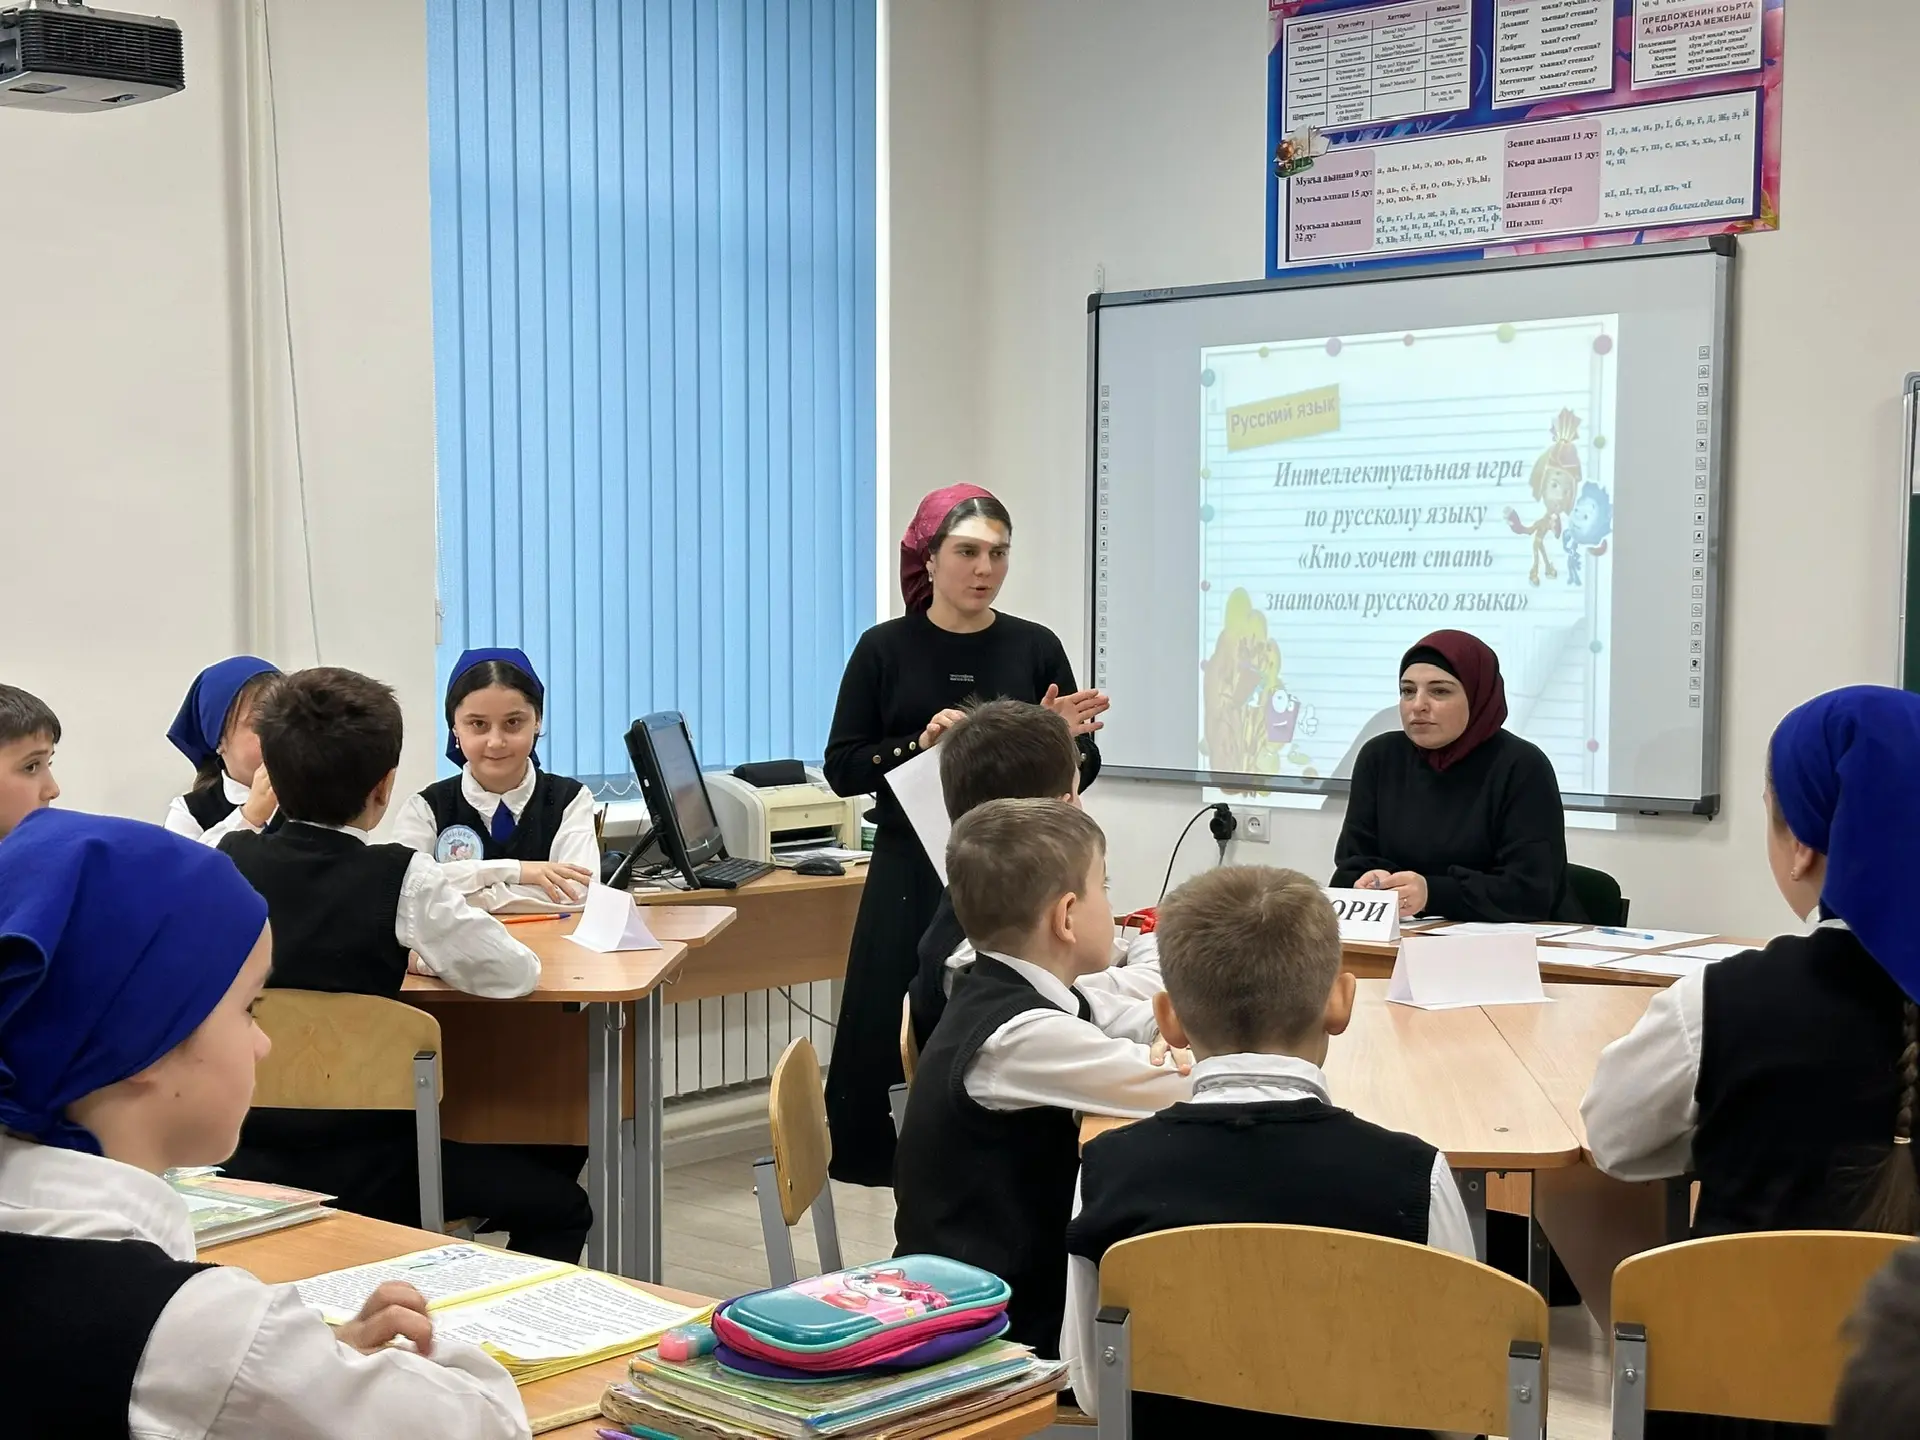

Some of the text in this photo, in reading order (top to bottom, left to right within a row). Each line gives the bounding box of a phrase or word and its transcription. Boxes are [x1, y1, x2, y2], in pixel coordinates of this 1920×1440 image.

[1642, 2, 1754, 24] ПРЕДЛОЖЕНИН КОЬРТА
[1704, 12, 1751, 25] МЕЖЕНАШ
[1361, 169, 1372, 177] ду:
[1549, 197, 1562, 205] ду:
[1506, 220, 1522, 228] Ши
[1231, 397, 1336, 436] Русский язык
[1274, 458, 1524, 489] Интеллектуальная игра
[1305, 504, 1487, 533] по русскому языку
[1298, 544, 1493, 570] «Кто хочет стать
[1266, 591, 1529, 617] знатоком русского языка»
